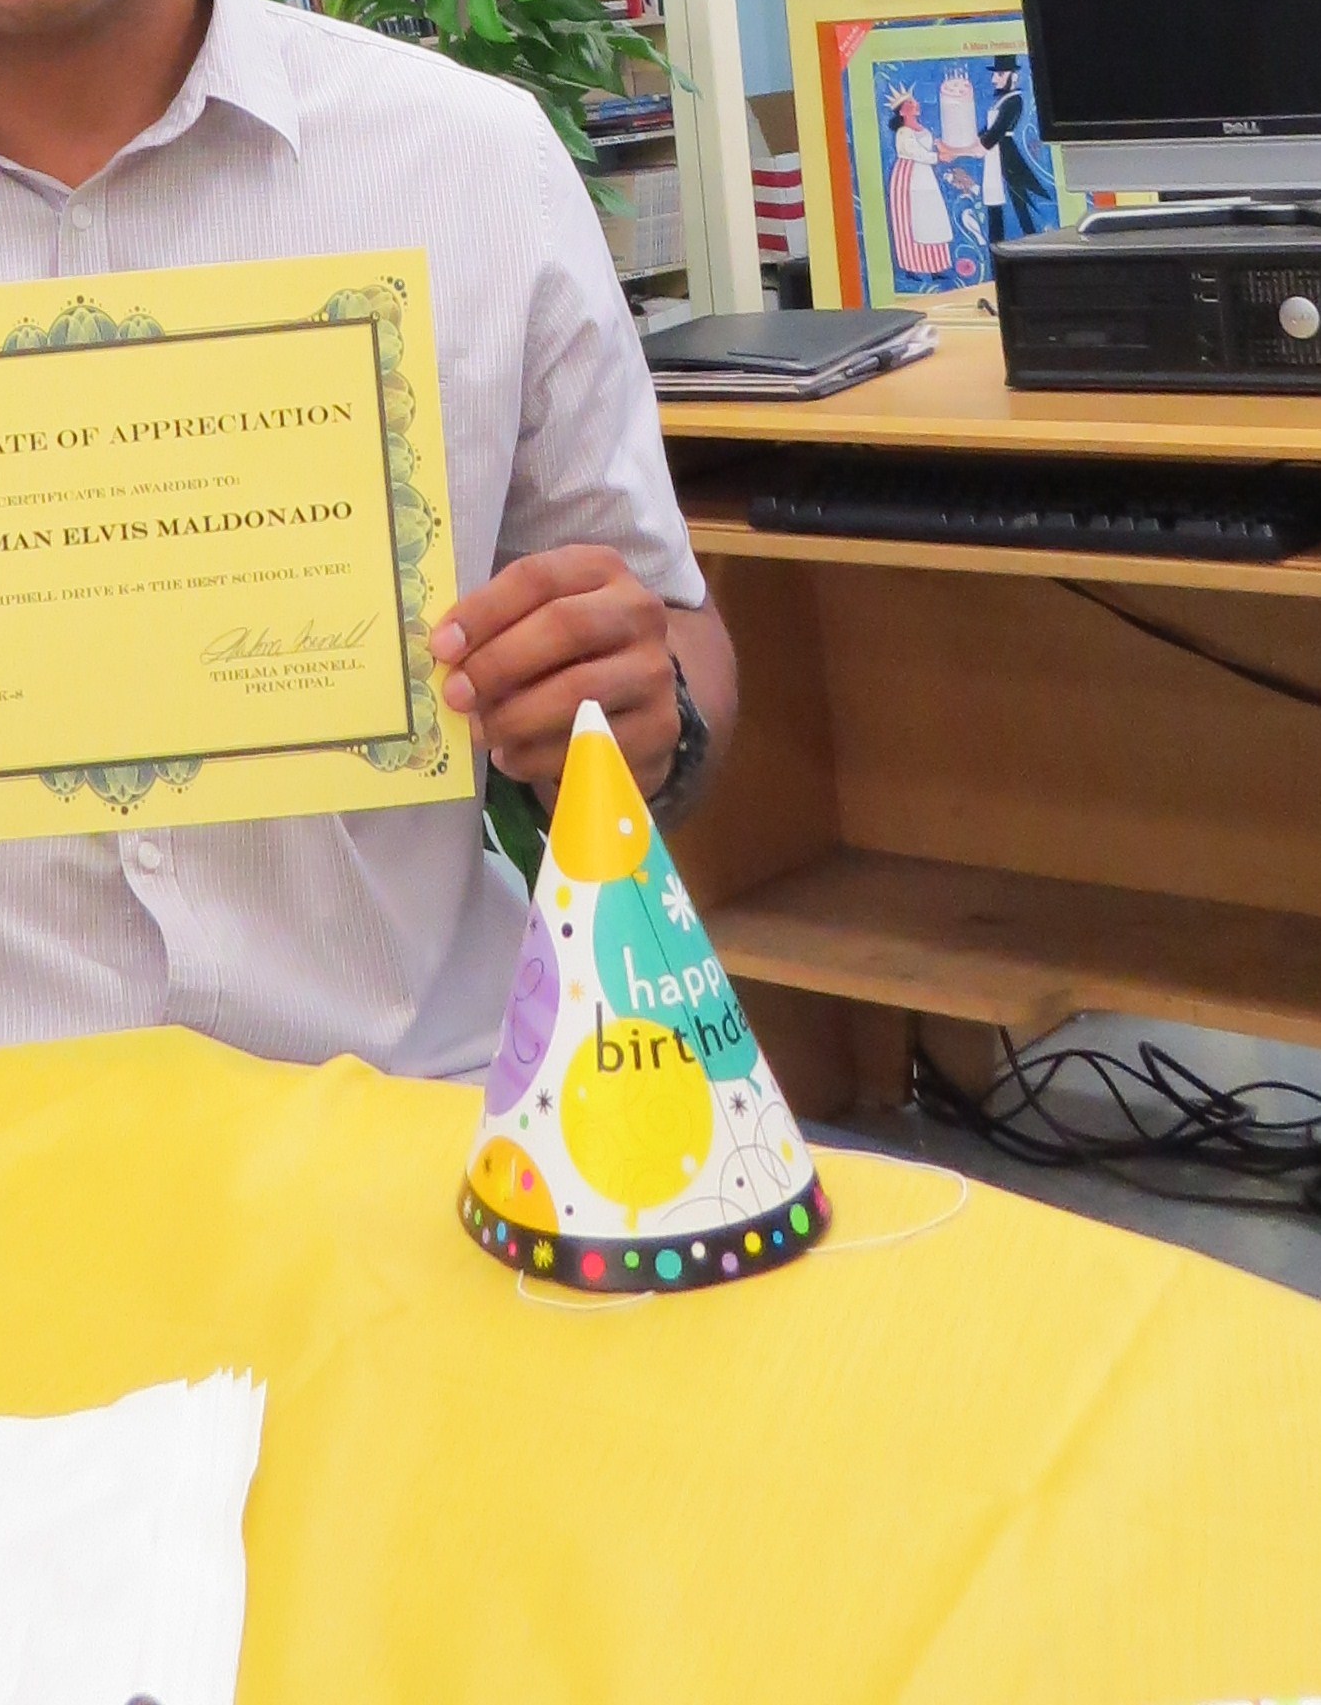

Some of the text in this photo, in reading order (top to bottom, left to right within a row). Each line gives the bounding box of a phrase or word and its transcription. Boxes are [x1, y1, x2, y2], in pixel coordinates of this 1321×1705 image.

[1222, 120, 1260, 134] DELL
[57, 427, 99, 449] OF
[109, 403, 352, 445] APPRECIATION
[110, 485, 126, 498] IS
[130, 478, 209, 496] AWARDED
[212, 475, 241, 488] TO:
[62, 520, 148, 546] ELVIS
[155, 501, 352, 538] MALDONADO
[61, 584, 114, 600] DRIVE
[118, 581, 146, 596] K-8
[149, 579, 183, 593] THE
[187, 574, 228, 589] BEST
[231, 567, 300, 584] SCHOOL
[303, 562, 351, 578] EVER!
[209, 667, 278, 683] THELMA
[245, 676, 335, 695] PRINCIPAL
[622, 945, 728, 1010] happ
[595, 1000, 751, 1073] birthda
